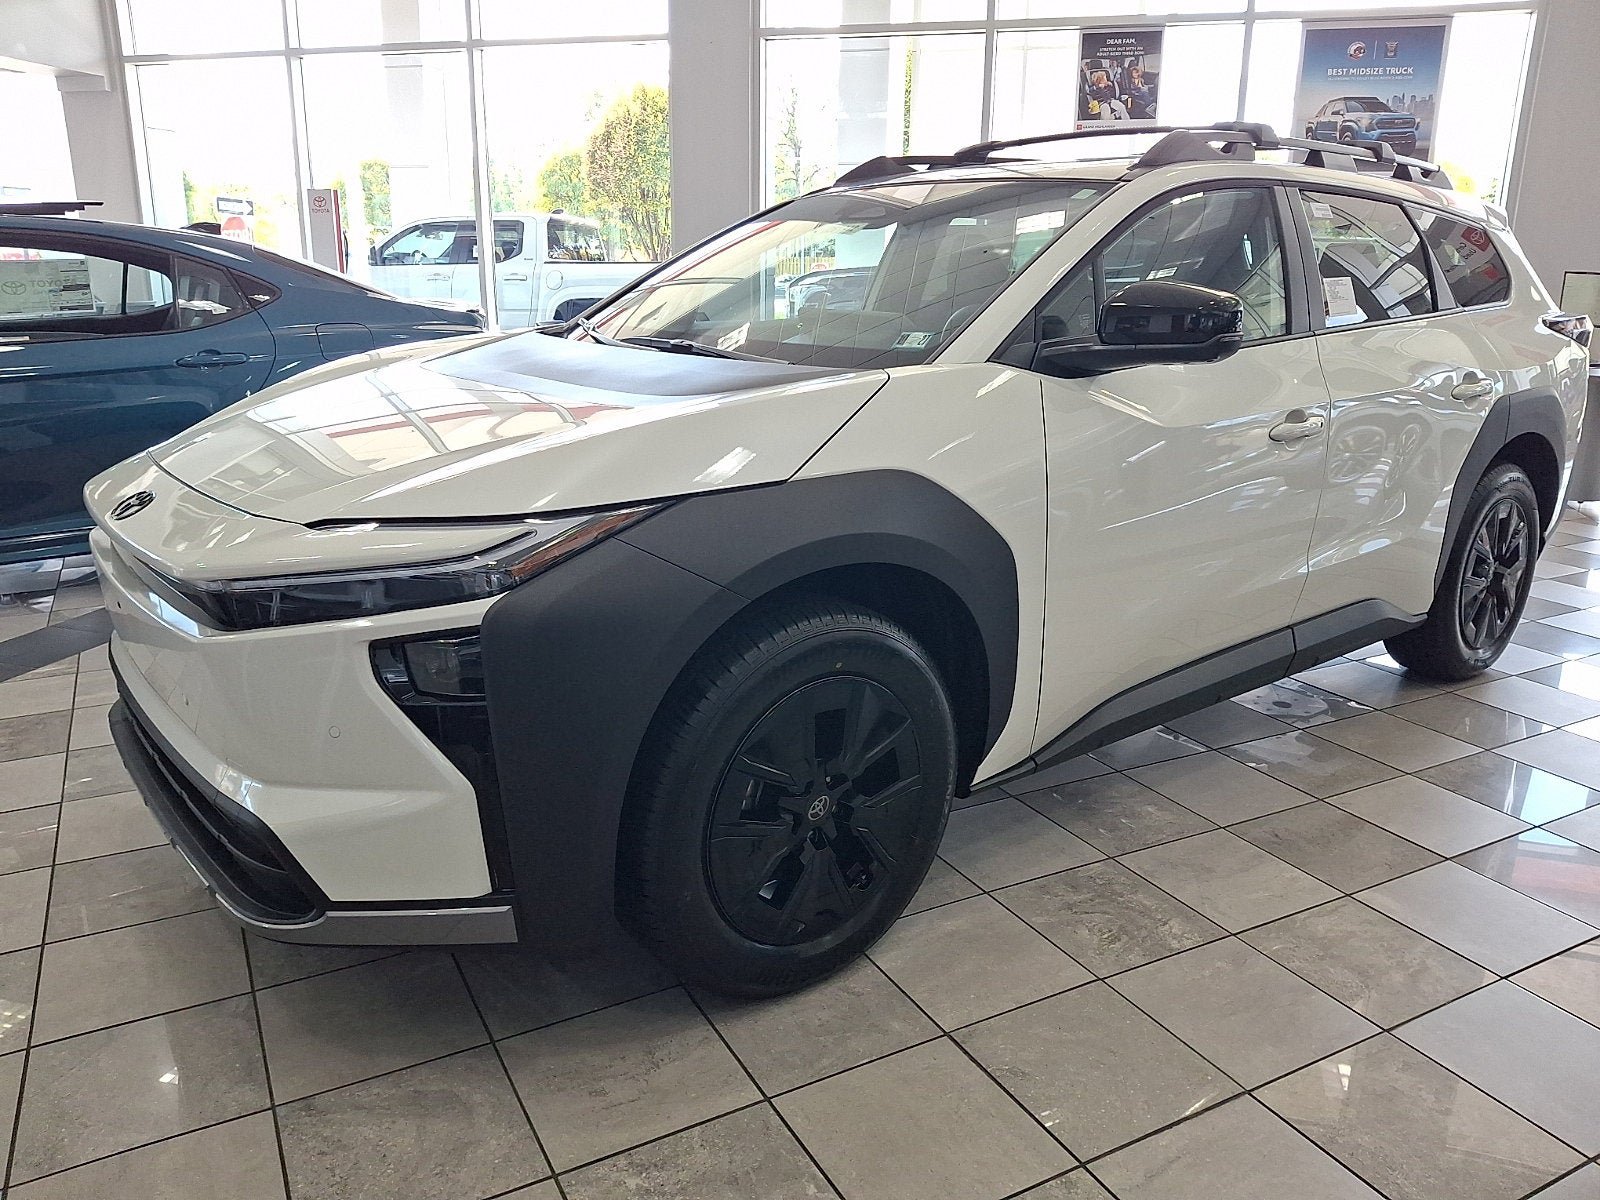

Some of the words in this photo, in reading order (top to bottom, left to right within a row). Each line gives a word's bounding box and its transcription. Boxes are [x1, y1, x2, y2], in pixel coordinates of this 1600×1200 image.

[1327, 68, 1348, 76] BEST
[1349, 67, 1384, 75] MIDSIZE
[1386, 66, 1414, 74] TRUCK
